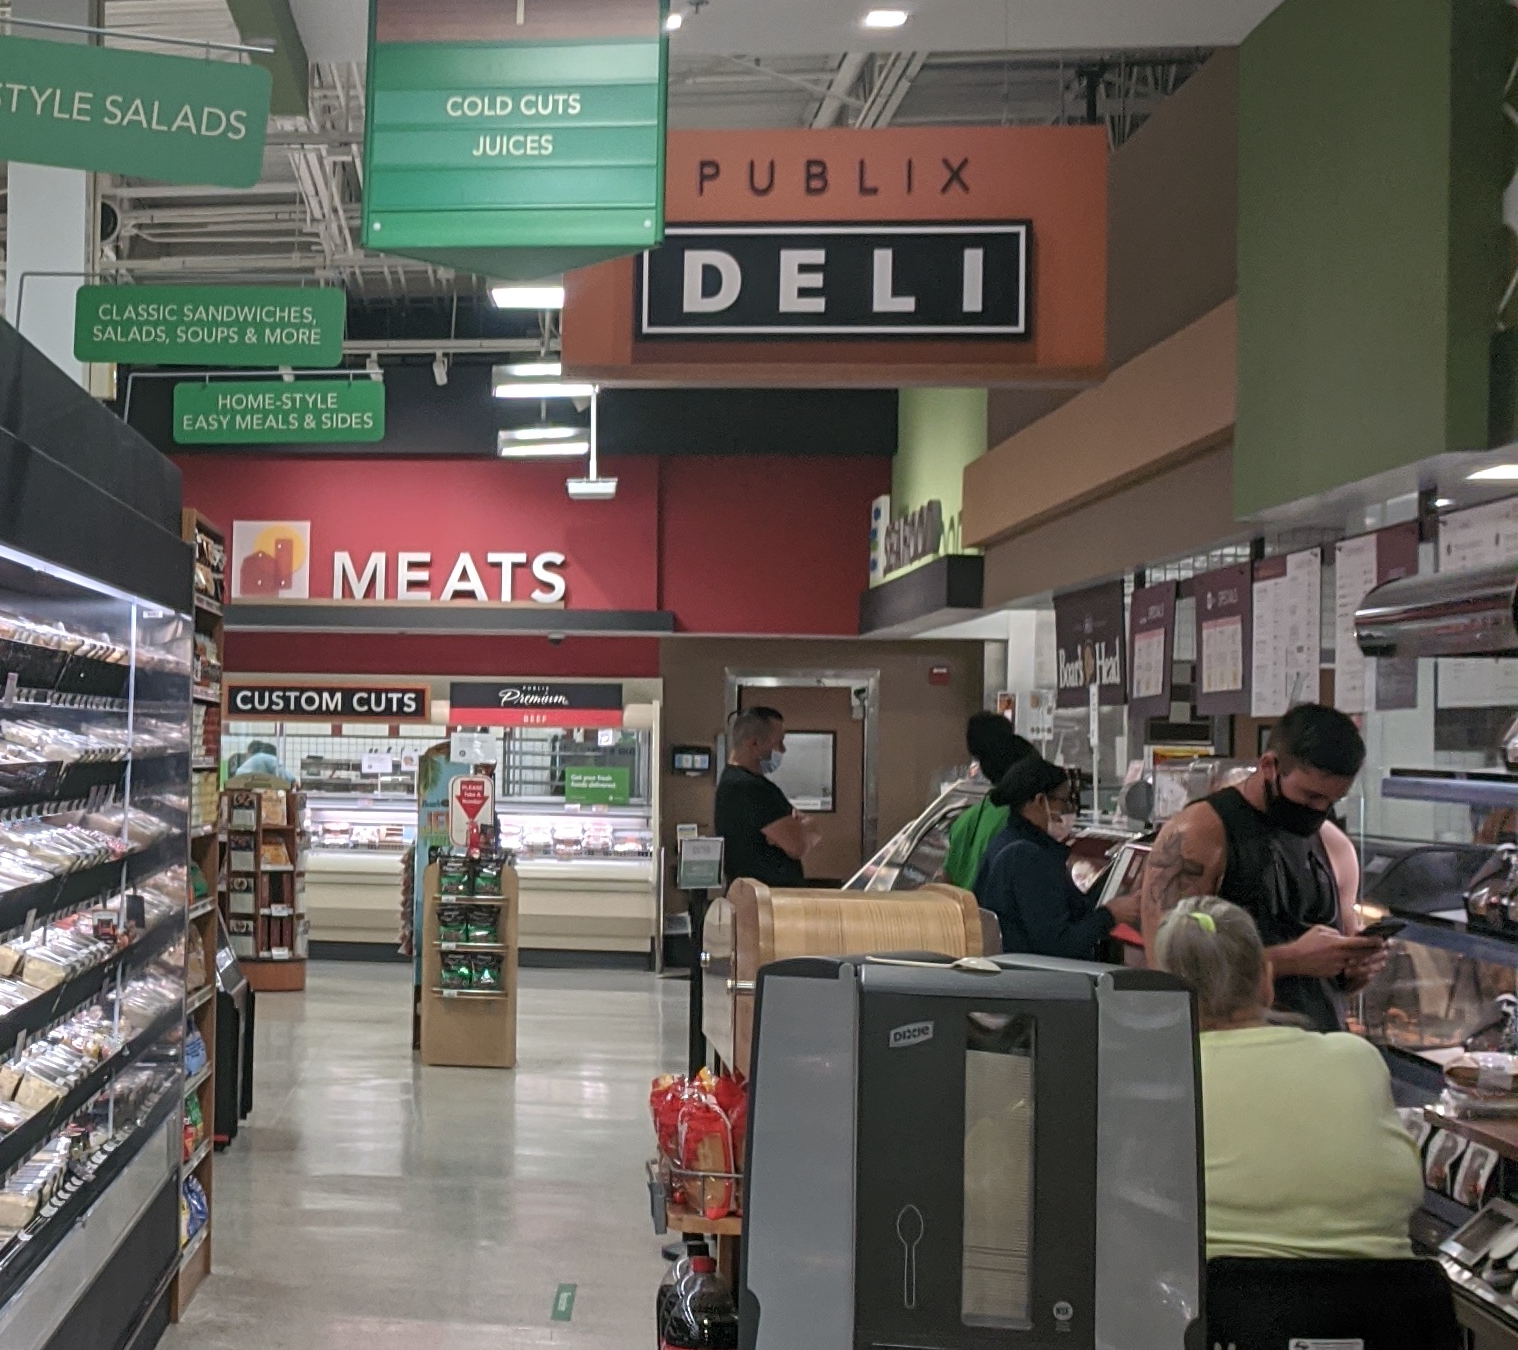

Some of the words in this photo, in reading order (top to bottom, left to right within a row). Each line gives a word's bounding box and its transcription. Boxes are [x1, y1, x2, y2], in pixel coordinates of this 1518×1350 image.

[446, 96, 512, 117] COLD
[520, 93, 581, 115] CUTS
[103, 96, 248, 141] SALADS
[472, 134, 553, 156] JUICES
[698, 157, 971, 196] PUBLIX
[682, 247, 984, 313] DELI
[97, 303, 177, 322] CLASSIC
[183, 305, 318, 326] SANDWICHES,
[93, 326, 170, 346] SALADS,
[176, 326, 238, 344] SOUPS
[245, 327, 258, 344] &
[265, 327, 321, 345] MORE
[217, 393, 338, 410] HOME-STYLE
[183, 414, 231, 431] EASY
[236, 414, 298, 430] MEALS
[304, 414, 317, 430] &
[321, 413, 373, 430] SIDES
[333, 550, 567, 603] MEATS
[1095, 635, 1121, 685] Head
[236, 689, 343, 712] CUSTOM
[358, 691, 417, 713] CUTS
[499, 689, 566, 706] Premium
[523, 714, 547, 723] BEEF
